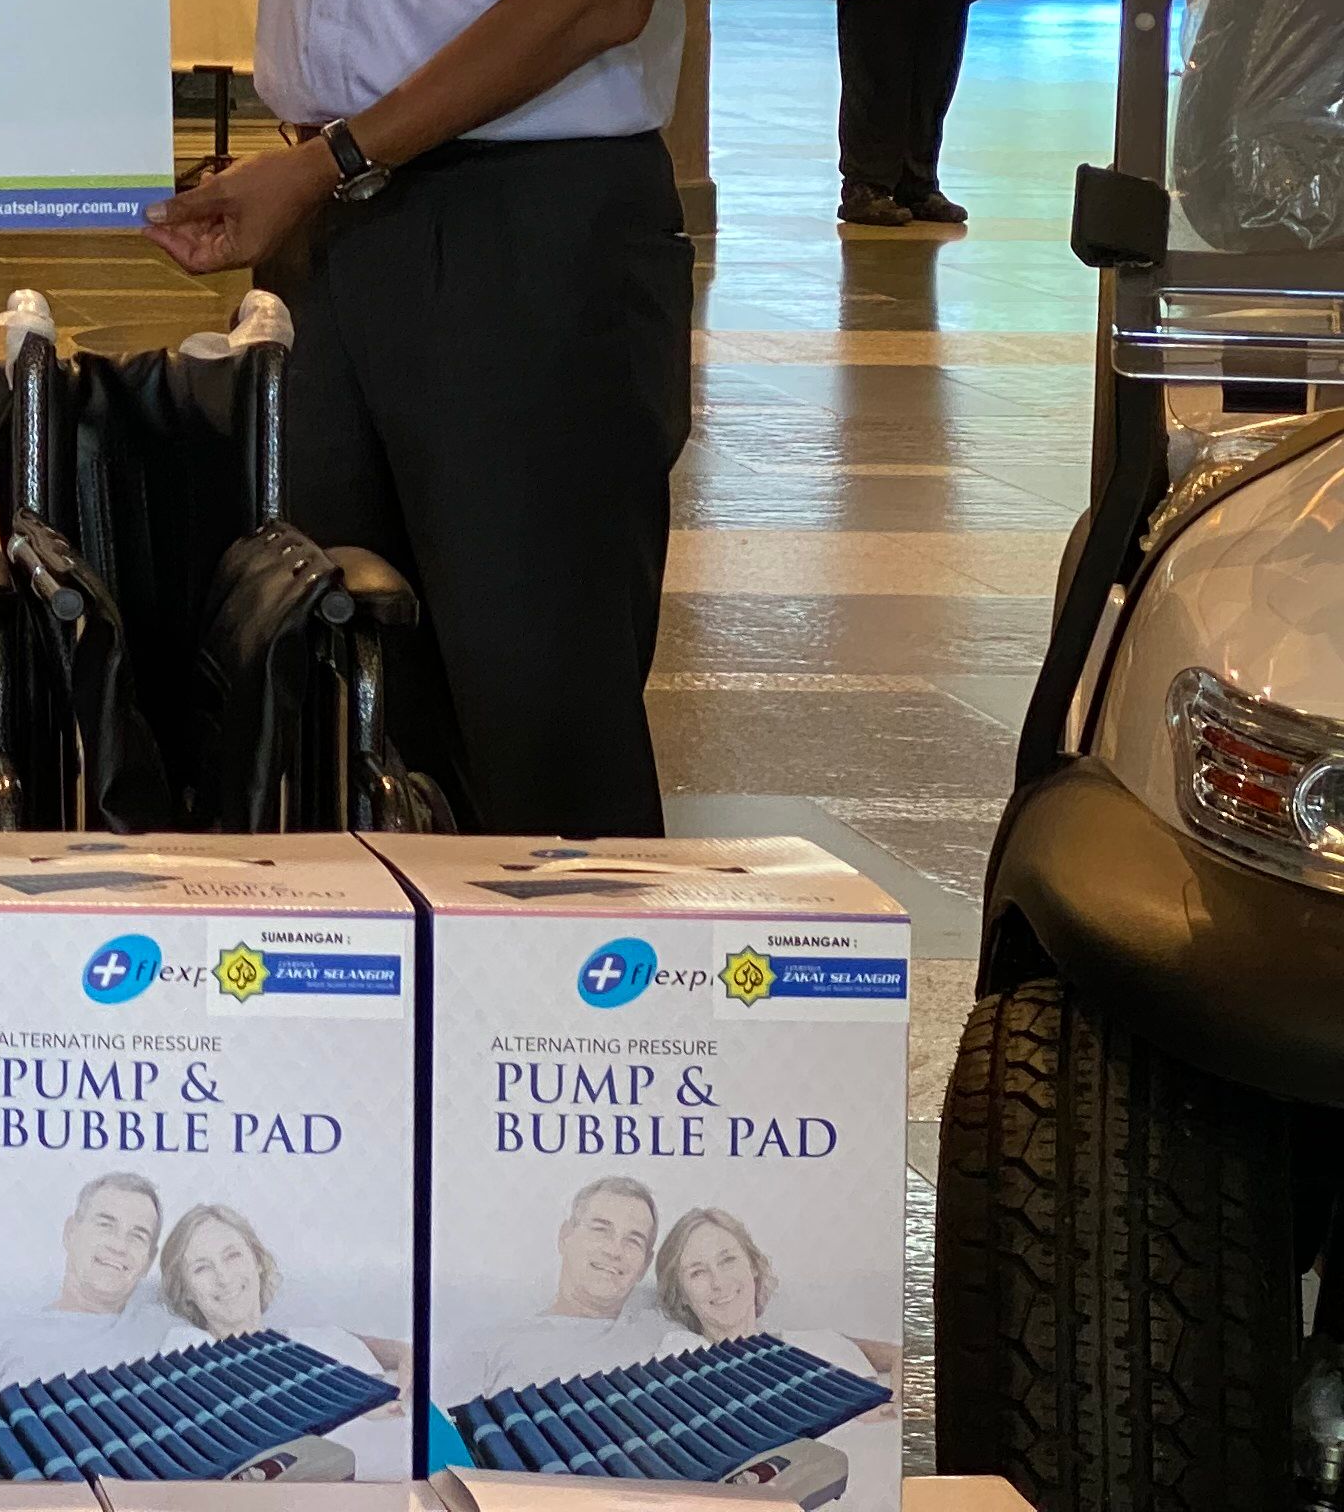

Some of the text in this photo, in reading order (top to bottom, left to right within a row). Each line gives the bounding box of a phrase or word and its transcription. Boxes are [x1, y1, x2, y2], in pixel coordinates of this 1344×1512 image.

[767, 935, 850, 948] SUMBANGAN
[782, 972, 901, 984] ZAKAT SELANGOR
[491, 1036, 718, 1056] ALTERNATING PRESSURE
[497, 1062, 723, 1107] PUMP &
[497, 1112, 837, 1158] BUBBLE PAD
